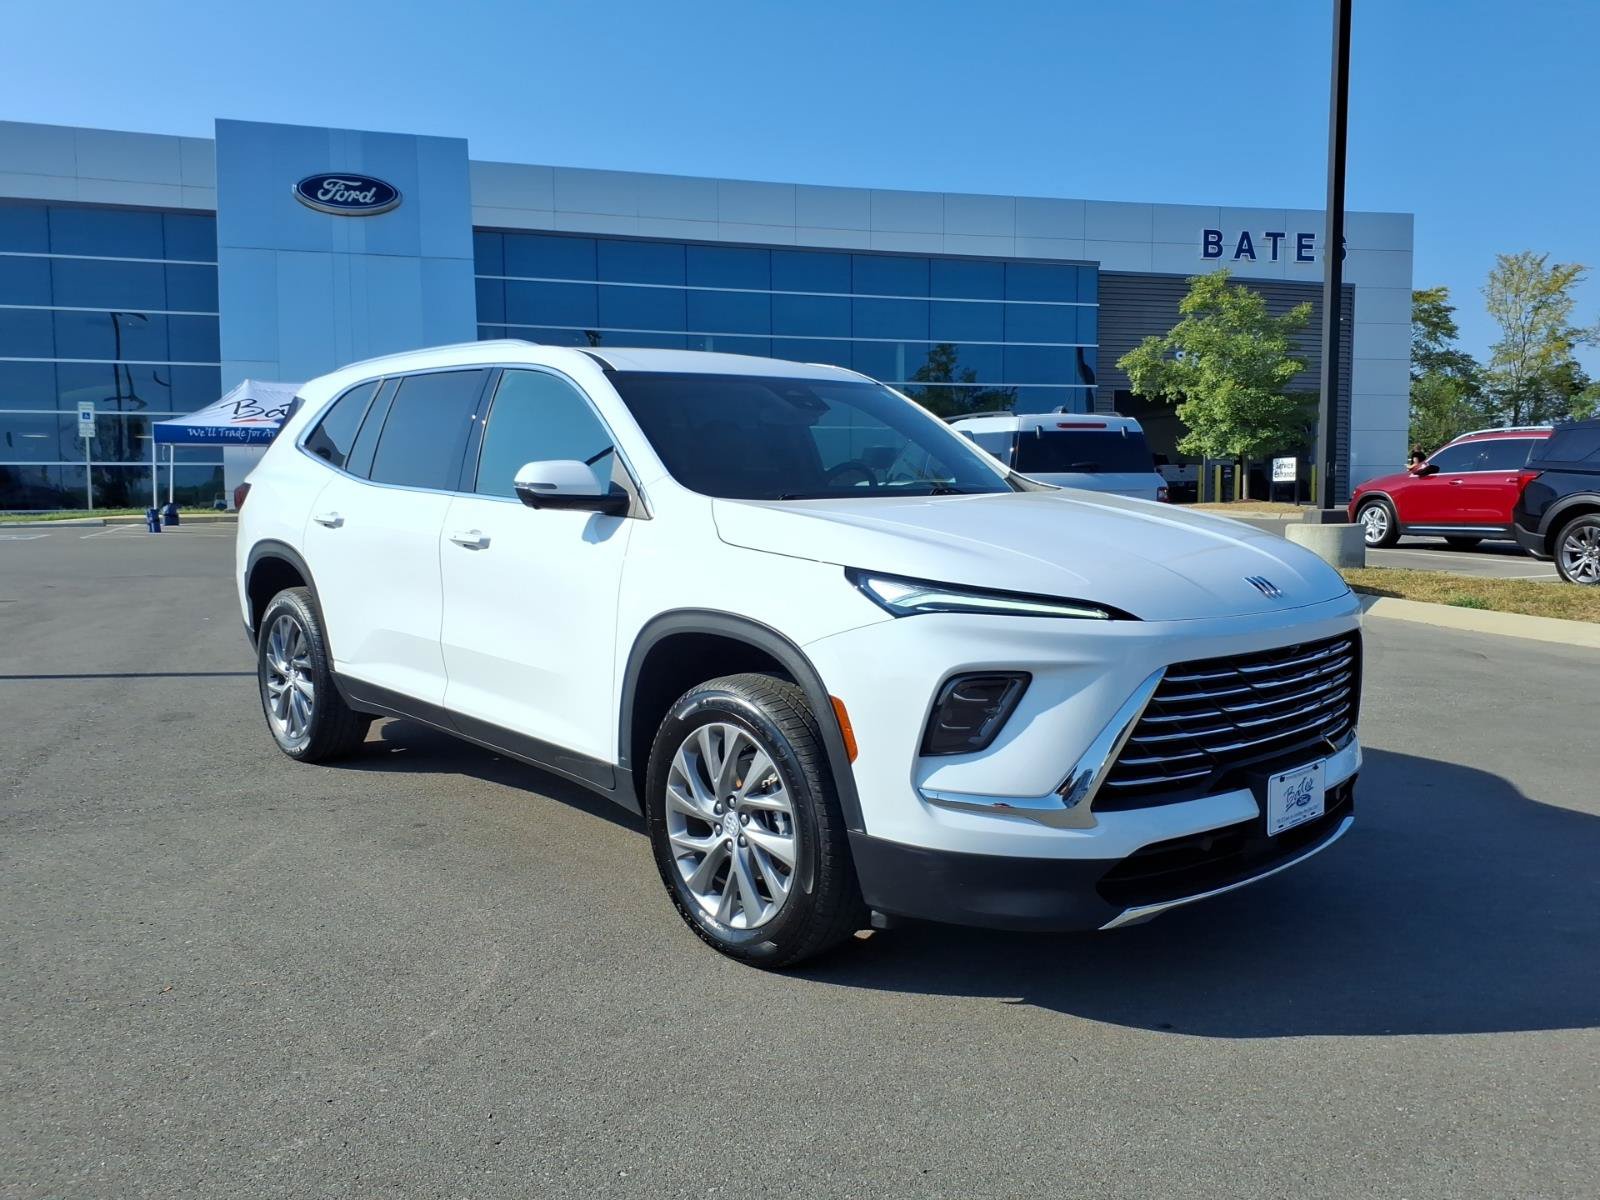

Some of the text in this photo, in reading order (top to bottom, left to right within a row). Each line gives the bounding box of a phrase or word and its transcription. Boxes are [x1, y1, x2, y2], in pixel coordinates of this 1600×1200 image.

[317, 179, 377, 203] Ford
[1202, 229, 1347, 262] BATE
[187, 428, 217, 437] We'll
[219, 429, 247, 440] Trade
[247, 429, 262, 443] for
